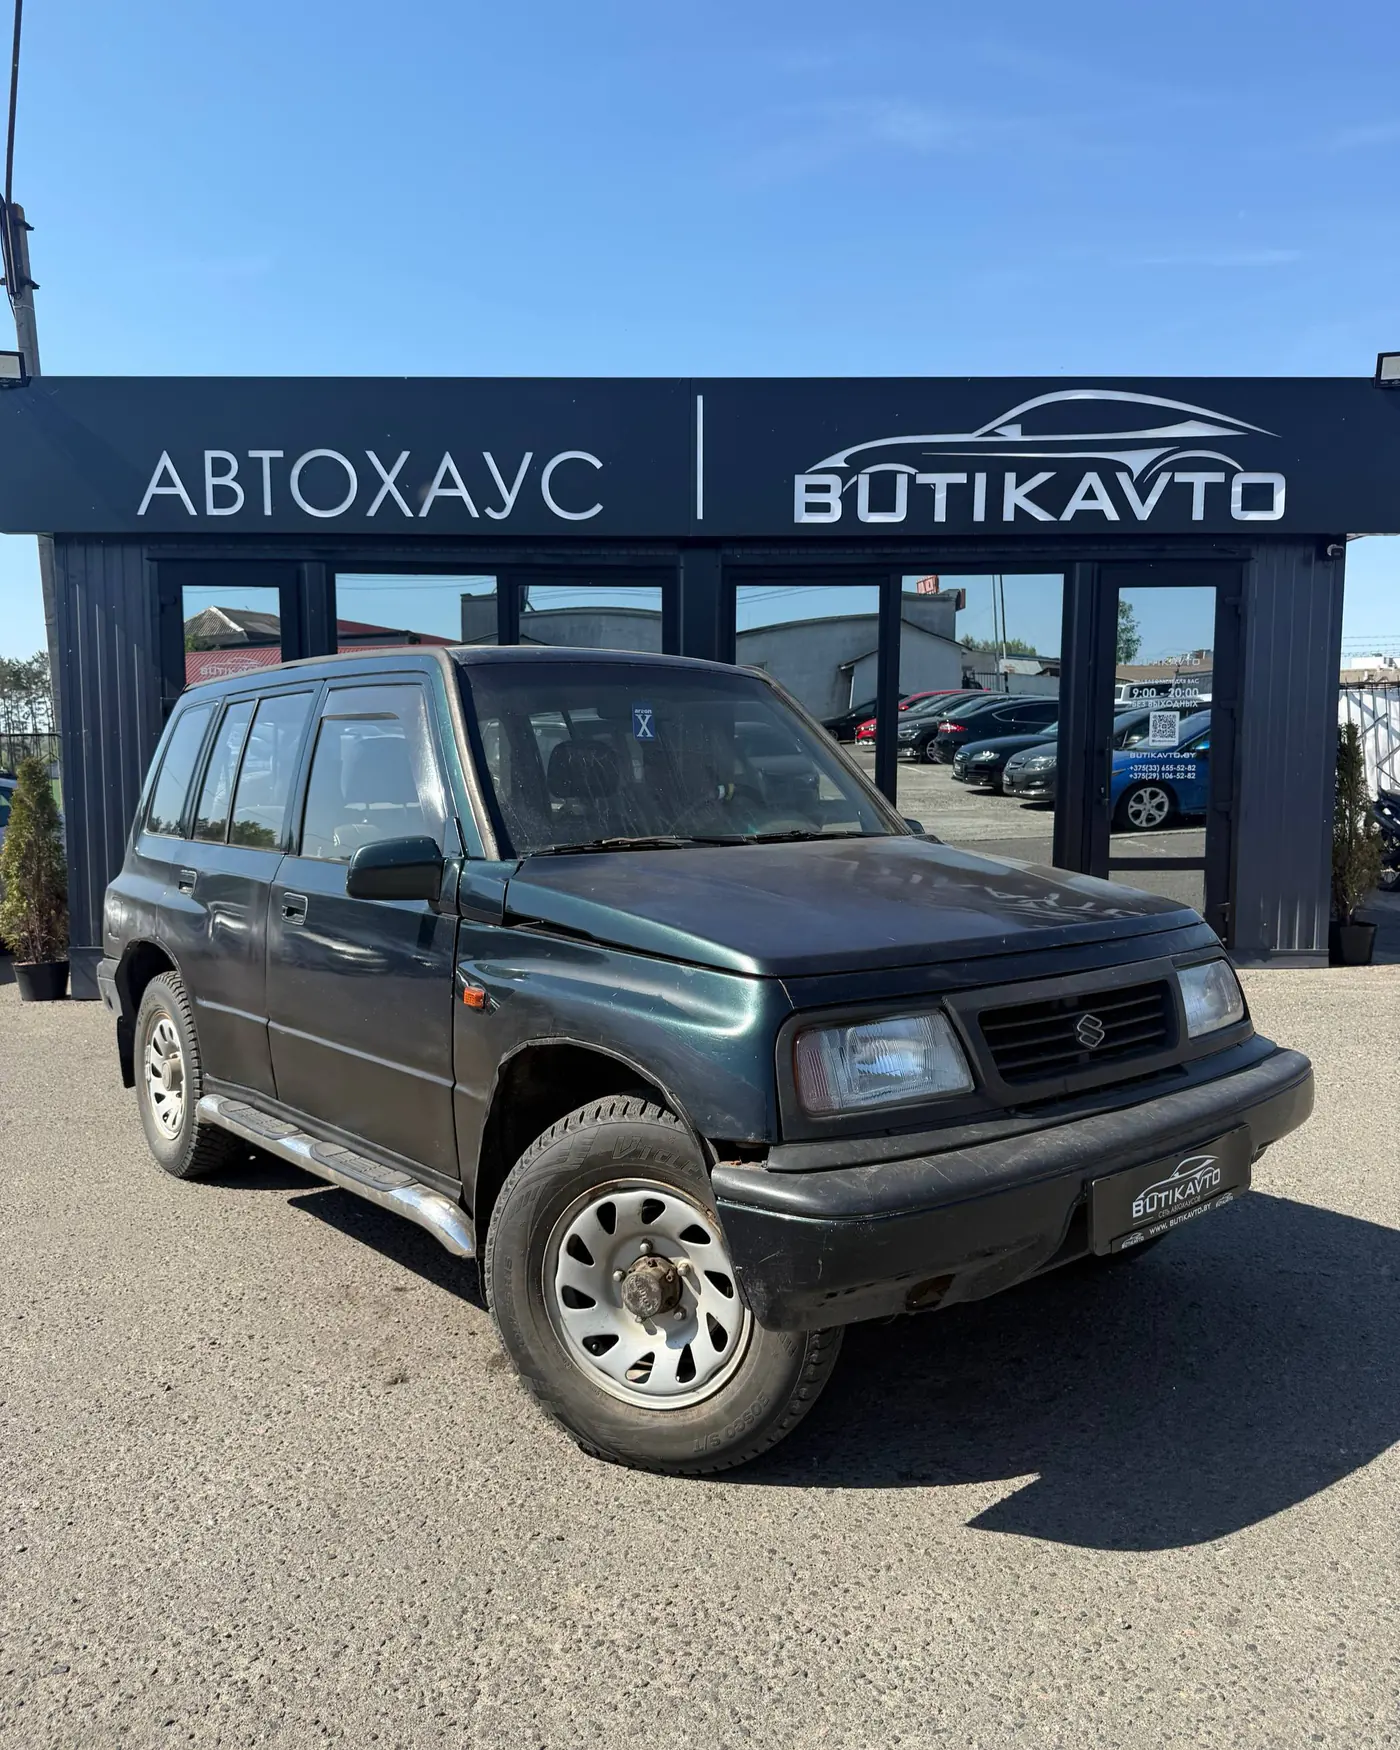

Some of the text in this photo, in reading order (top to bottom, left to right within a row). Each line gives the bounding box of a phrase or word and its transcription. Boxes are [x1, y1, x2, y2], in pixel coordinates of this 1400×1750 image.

[137, 448, 604, 521] АВТОХАУС
[793, 471, 1286, 523] BUTIKAVTO
[1132, 687, 1157, 698] 9:00
[1168, 687, 1199, 698] 20:00
[1131, 700, 1198, 709] БЕЗ ВЫХОДНЫХ
[635, 714, 654, 737] X
[1128, 772, 1196, 780] +375(29) 106-52-82
[1129, 764, 1196, 773] +375(33) 655-52-82
[1132, 1168, 1221, 1218] BUTIKAVTO
[1169, 1202, 1212, 1227] BUTIKAVTO.BY
